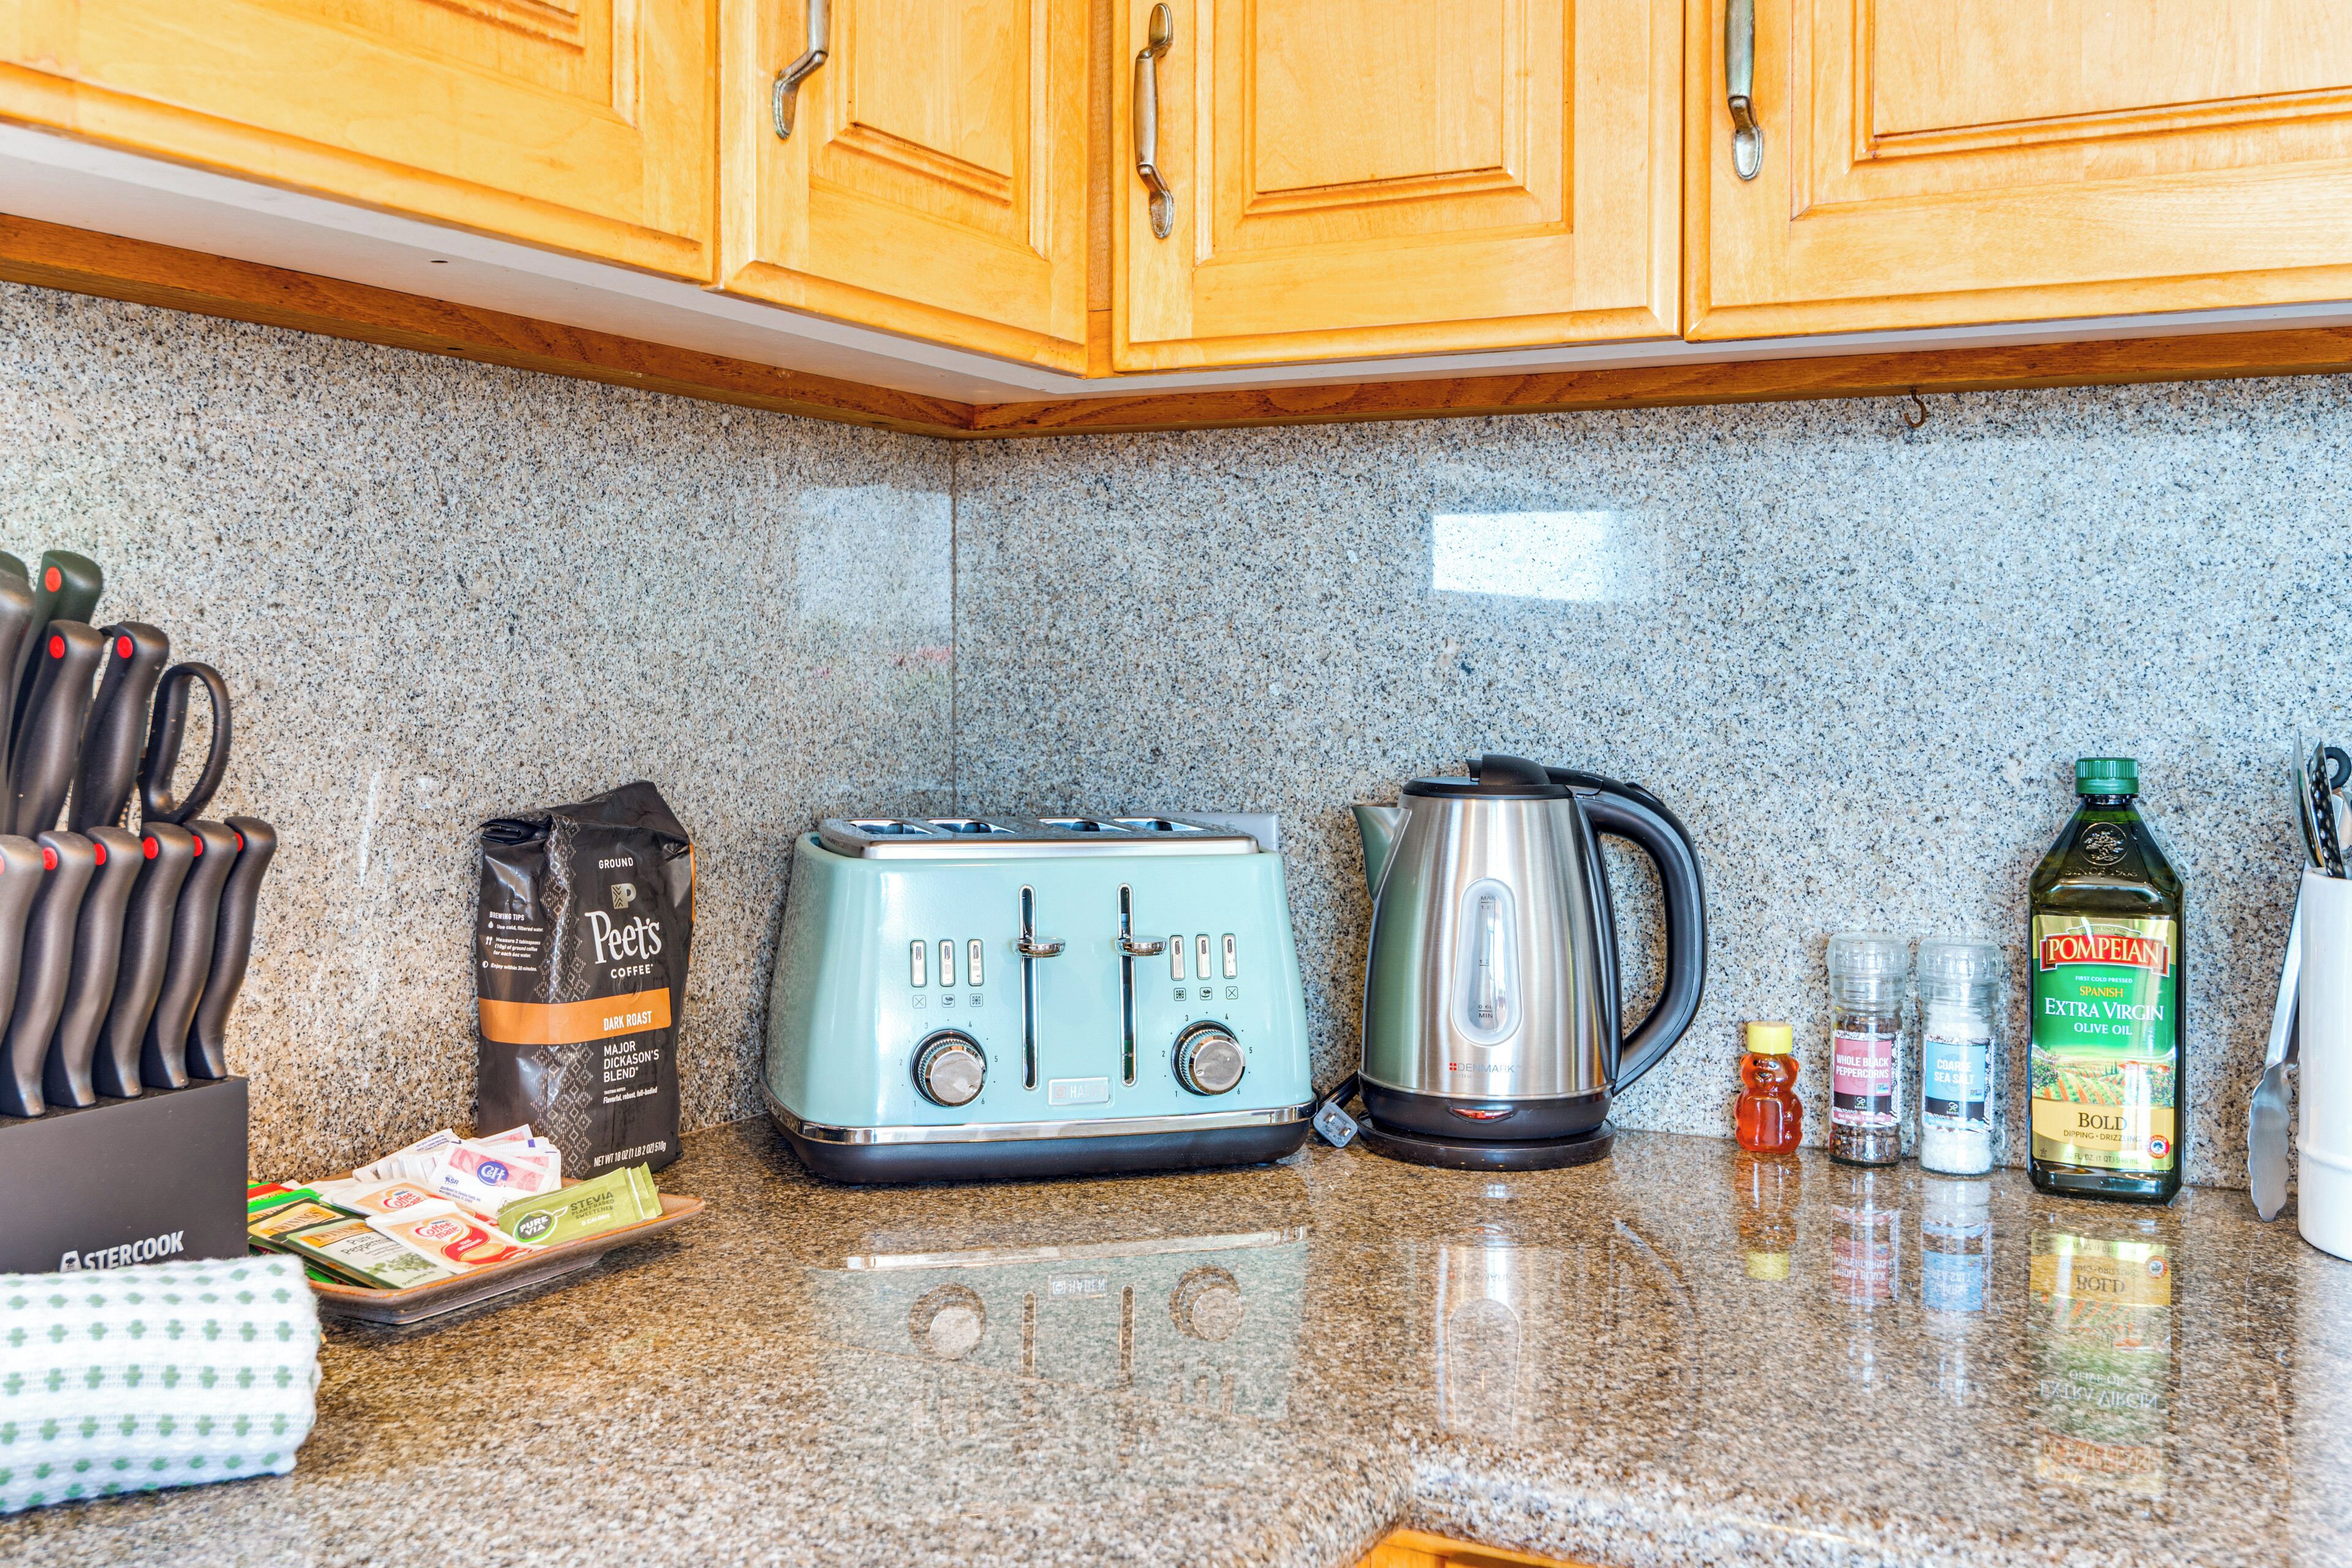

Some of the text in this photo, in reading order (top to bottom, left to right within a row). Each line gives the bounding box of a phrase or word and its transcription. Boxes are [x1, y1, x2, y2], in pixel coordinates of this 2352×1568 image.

[598, 857, 633, 869] GROUND
[489, 911, 511, 920] BREWING
[584, 910, 662, 965] Peet's
[2048, 937, 2160, 965] POMPEIAN
[2079, 986, 2124, 998] SPANISH
[2045, 997, 2164, 1021] EXTRA VIRGIN
[603, 1011, 652, 1031] DARK ROAST
[2074, 1022, 2133, 1035] OLIVE OIL
[604, 1041, 636, 1057] MAJOR
[604, 1049, 659, 1069] DICKASON'S
[1836, 1054, 1889, 1067] WHOLE BLACK
[1937, 1059, 1972, 1072] COARSE
[1458, 1063, 1515, 1073] DENMARK
[1836, 1066, 1889, 1078] PEPPERCORNS
[1934, 1071, 1975, 1085] SEA SALT
[603, 1095, 622, 1104] Flavorful,
[636, 1086, 658, 1098] full-bodied
[2078, 1112, 2127, 1130] BOLD
[2064, 1130, 2141, 1142] DIPPING DRIZZLING
[594, 1140, 666, 1167] NET WT 18 OZ (1 LB 2 OZ) 510g
[481, 1165, 505, 1183] C&H
[383, 1193, 417, 1208] Coffee
[570, 1191, 614, 1211] STEVIA
[571, 1199, 615, 1216] PLANT-BASED
[575, 1205, 614, 1219] SWEETENER
[587, 1213, 611, 1225] CALORIE
[268, 1208, 324, 1234] TWININGS
[520, 1215, 549, 1233] PURE
[415, 1221, 454, 1237] Coffee
[434, 1227, 460, 1240] mate
[524, 1224, 546, 1236] VIA
[347, 1235, 374, 1245] Pure
[458, 1238, 483, 1251] ORIGINAL
[460, 1238, 472, 1246] THE
